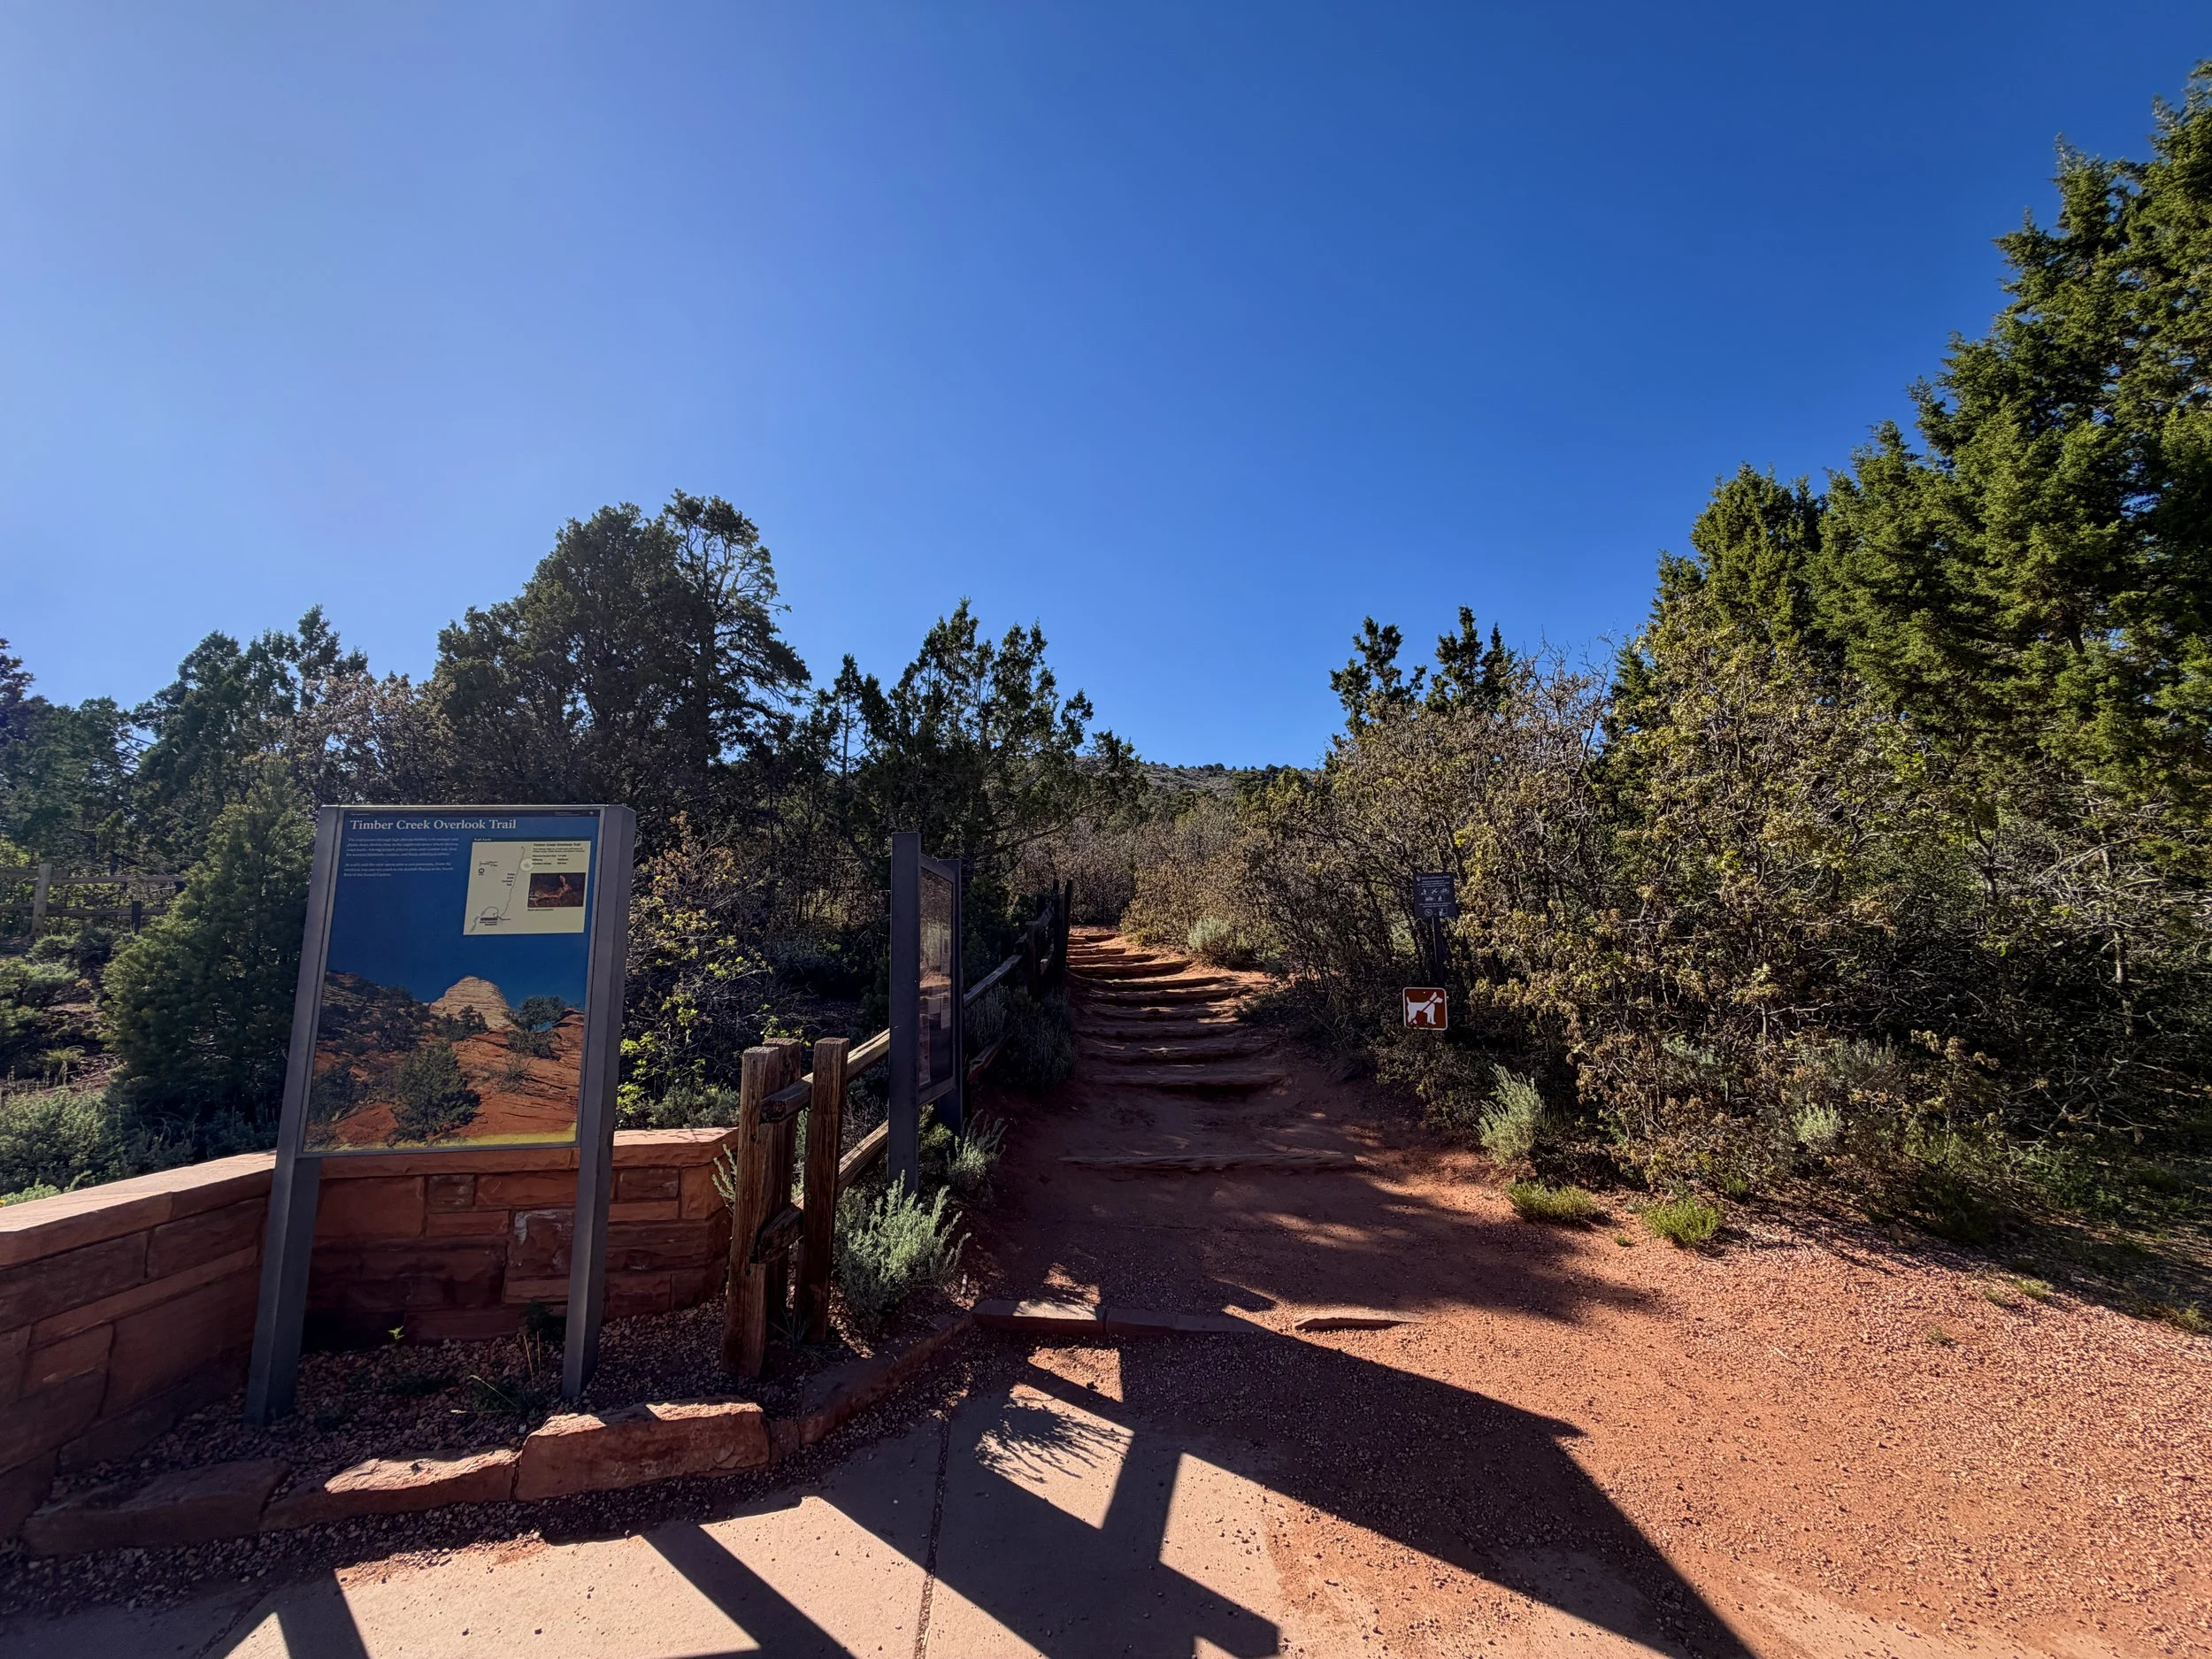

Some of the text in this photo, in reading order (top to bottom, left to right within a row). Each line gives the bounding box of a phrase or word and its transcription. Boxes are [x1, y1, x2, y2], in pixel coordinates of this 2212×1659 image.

[350, 819, 517, 829] Timber Creek Overlook Trail
